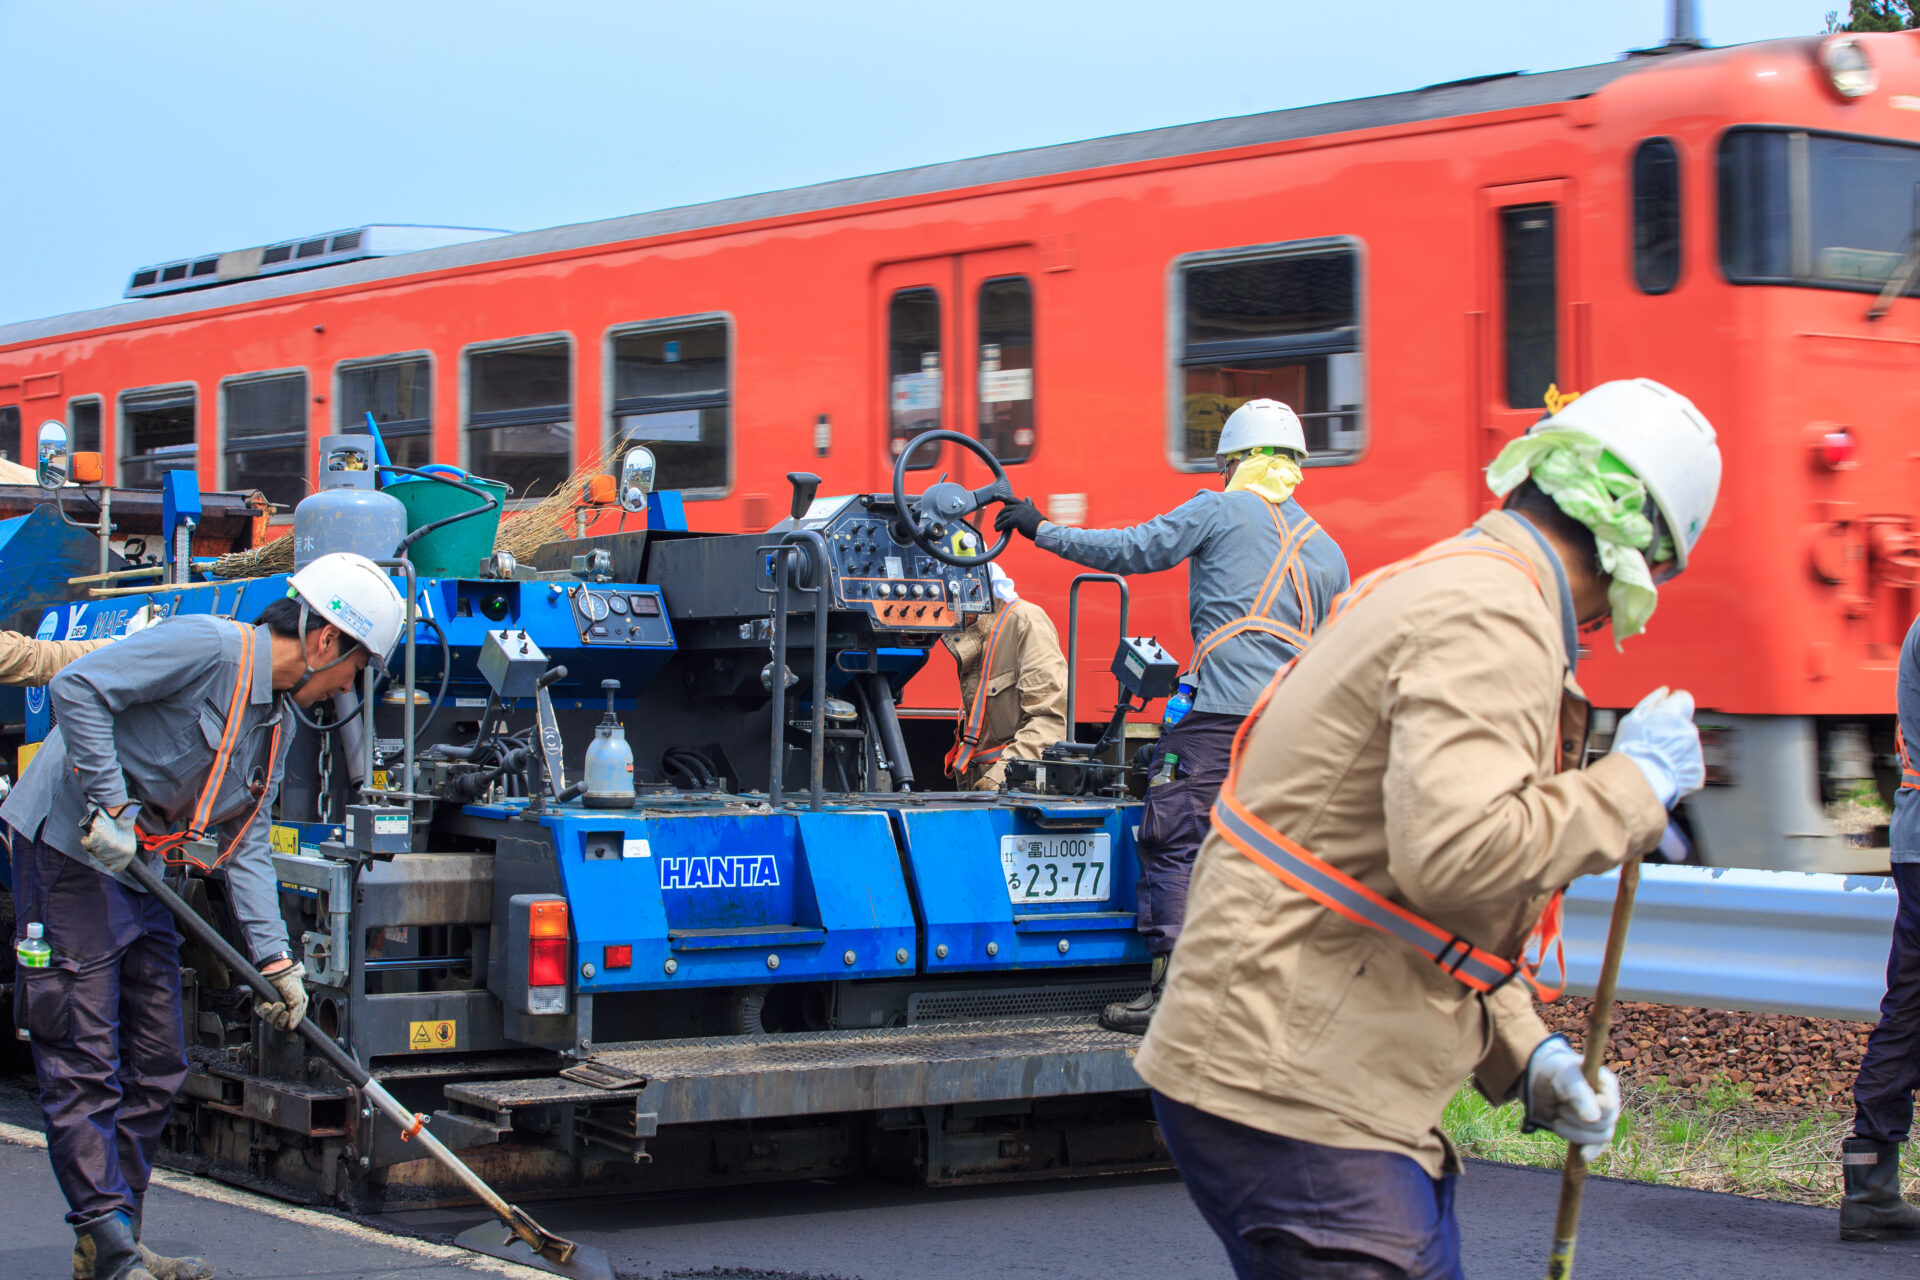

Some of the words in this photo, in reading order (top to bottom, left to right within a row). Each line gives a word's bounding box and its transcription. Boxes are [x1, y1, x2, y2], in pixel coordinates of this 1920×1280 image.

[71, 626, 87, 637] DEC
[661, 854, 780, 889] HANTA
[1008, 872, 1021, 889] る
[1025, 861, 1104, 897] 23-77
